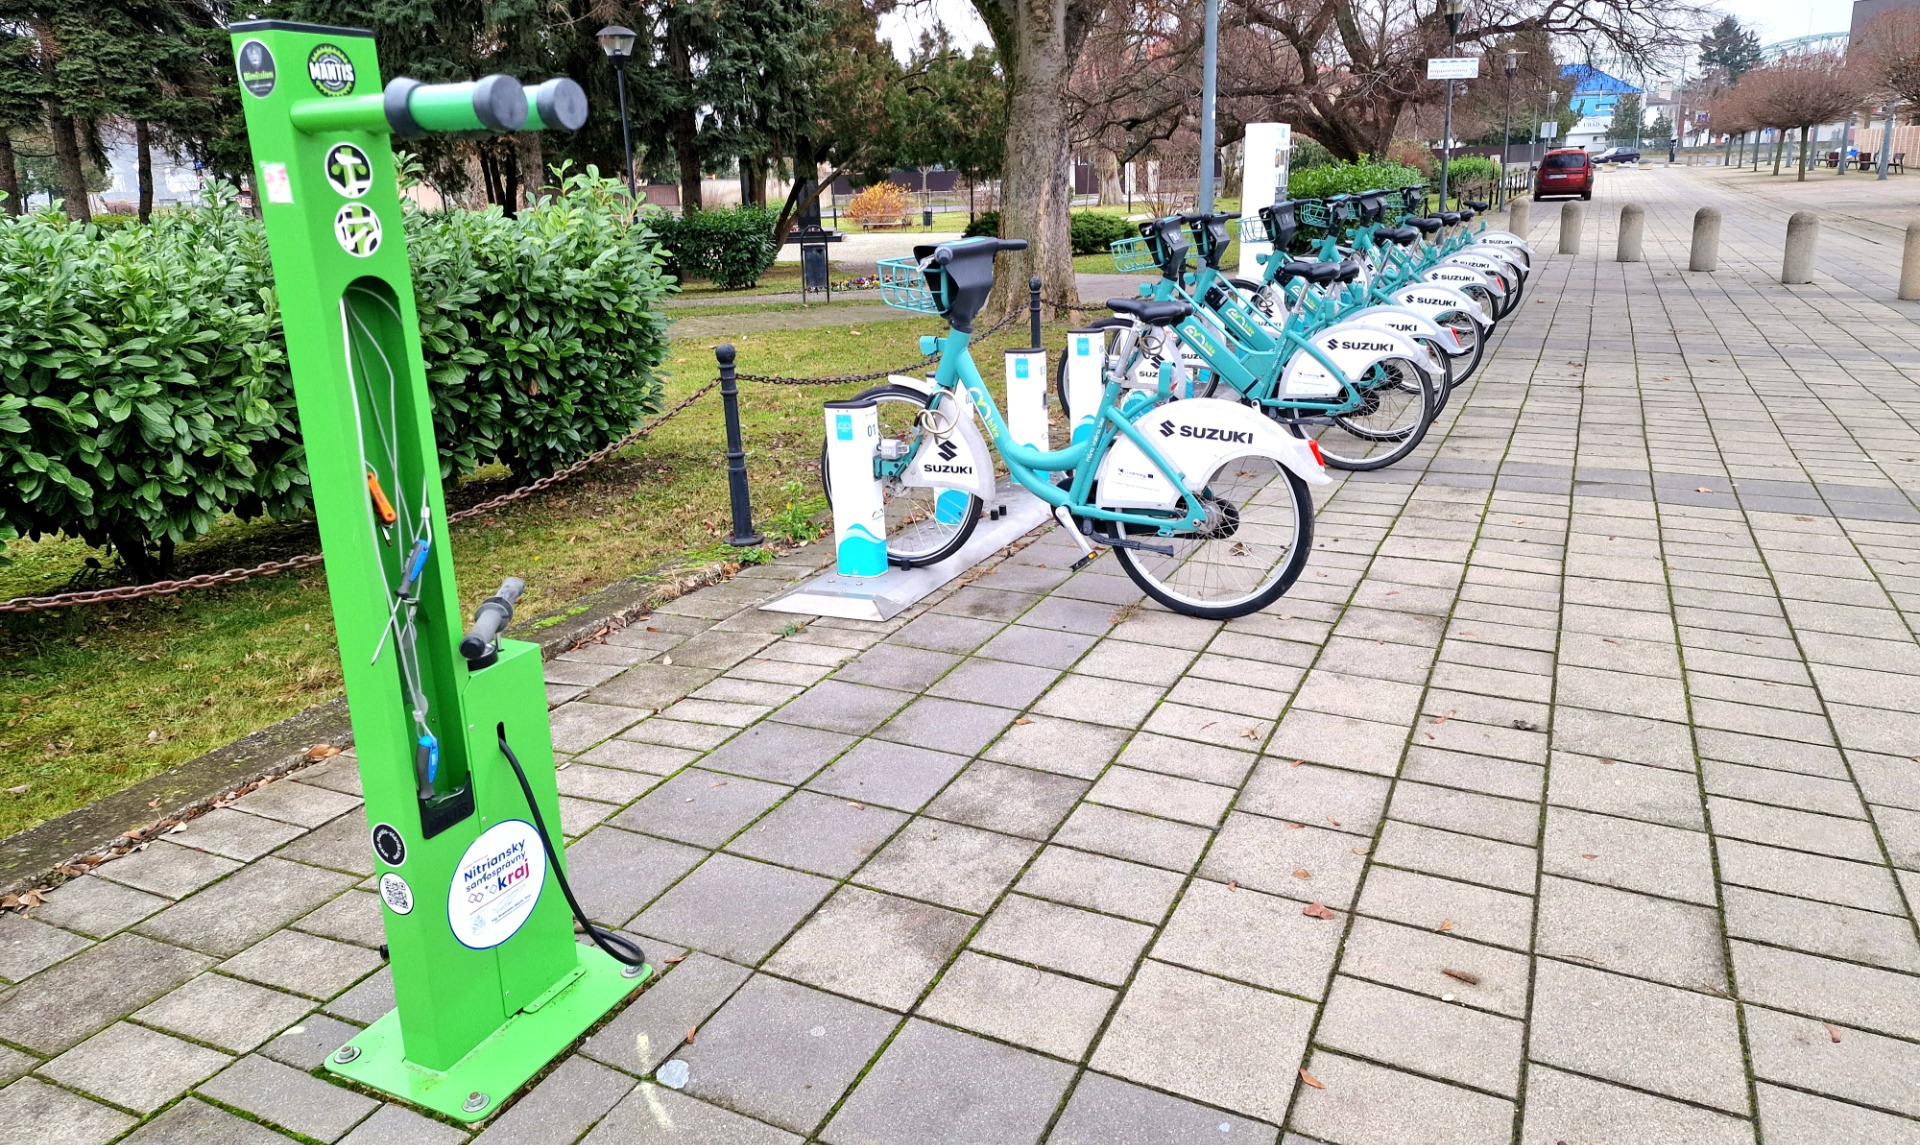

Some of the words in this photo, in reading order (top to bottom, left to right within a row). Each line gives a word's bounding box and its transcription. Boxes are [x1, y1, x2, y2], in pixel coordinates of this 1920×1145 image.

[309, 62, 355, 82] MANTIS
[1441, 274, 1475, 282] SUZUKI
[1416, 296, 1457, 307] SUZUKI
[1341, 340, 1394, 352] SUZUKI
[867, 424, 877, 437] 01
[1179, 424, 1254, 445] SUZUKI
[923, 463, 973, 475] SUZUKI
[464, 838, 526, 883] Nitriansky
[497, 858, 530, 892] kraj
